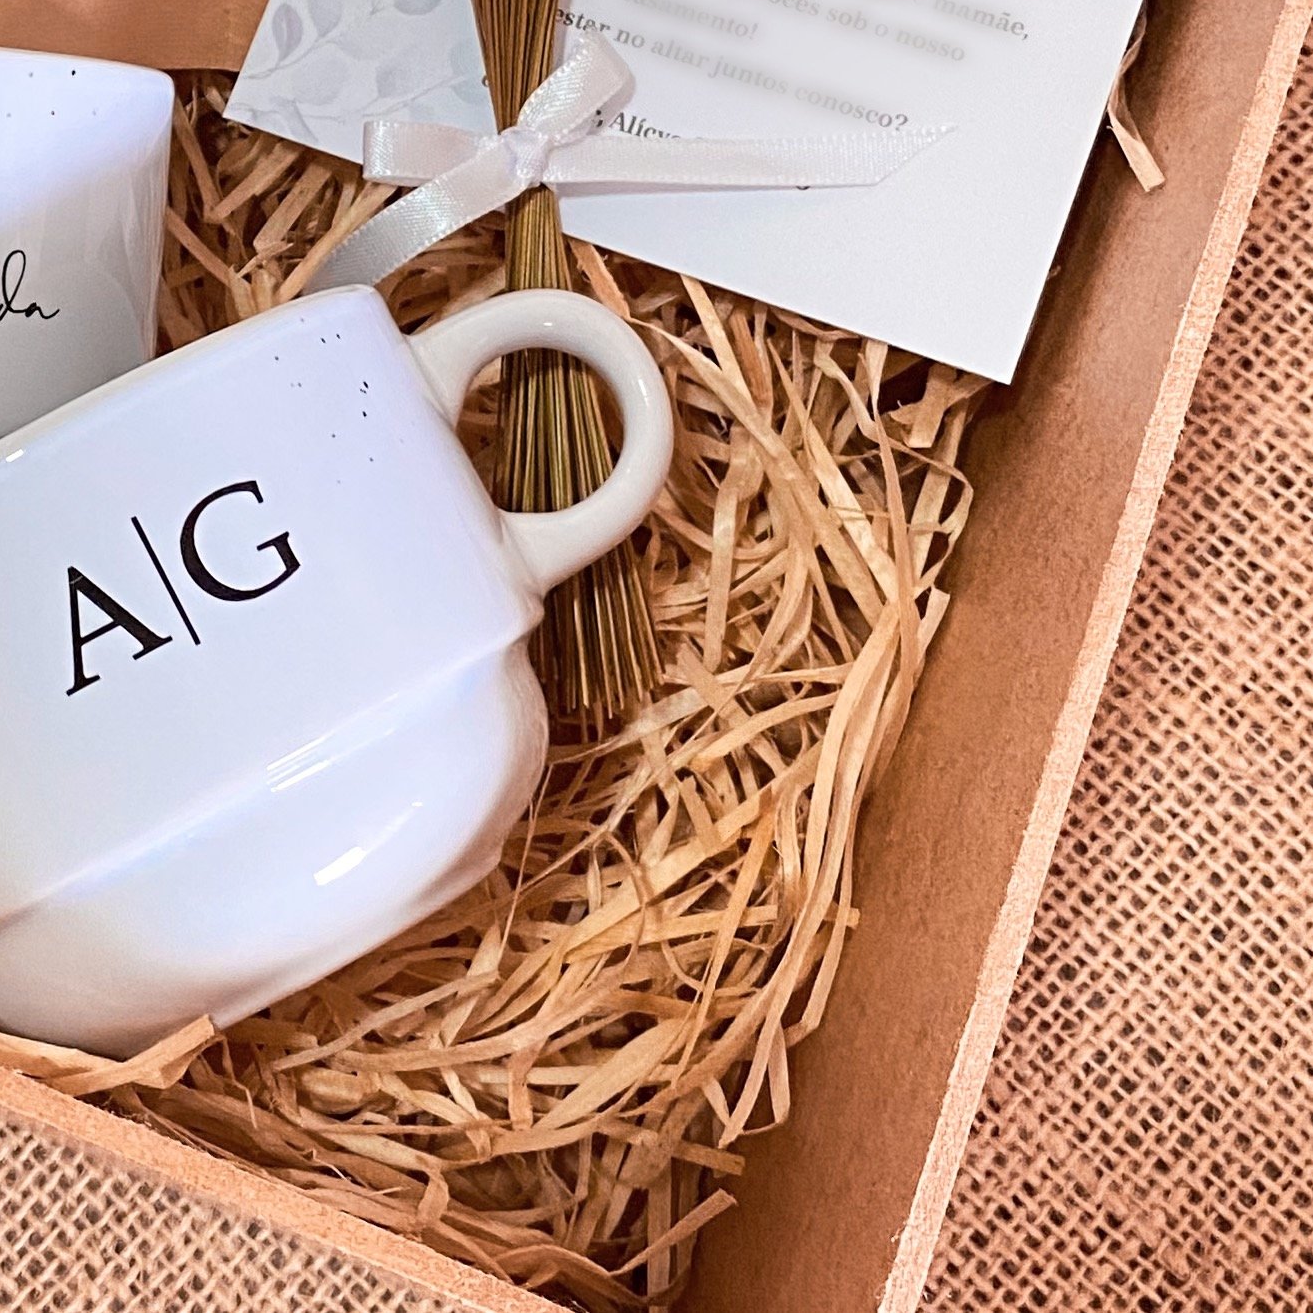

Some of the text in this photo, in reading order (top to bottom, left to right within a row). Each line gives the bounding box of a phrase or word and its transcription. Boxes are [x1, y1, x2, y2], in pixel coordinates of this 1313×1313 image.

[825, 5, 868, 32] sob
[873, 18, 890, 39] o
[894, 27, 967, 63] nosso
[613, 28, 648, 49] no
[649, 39, 710, 69] altar
[706, 56, 791, 95] juntos
[793, 84, 910, 133] conosco?
